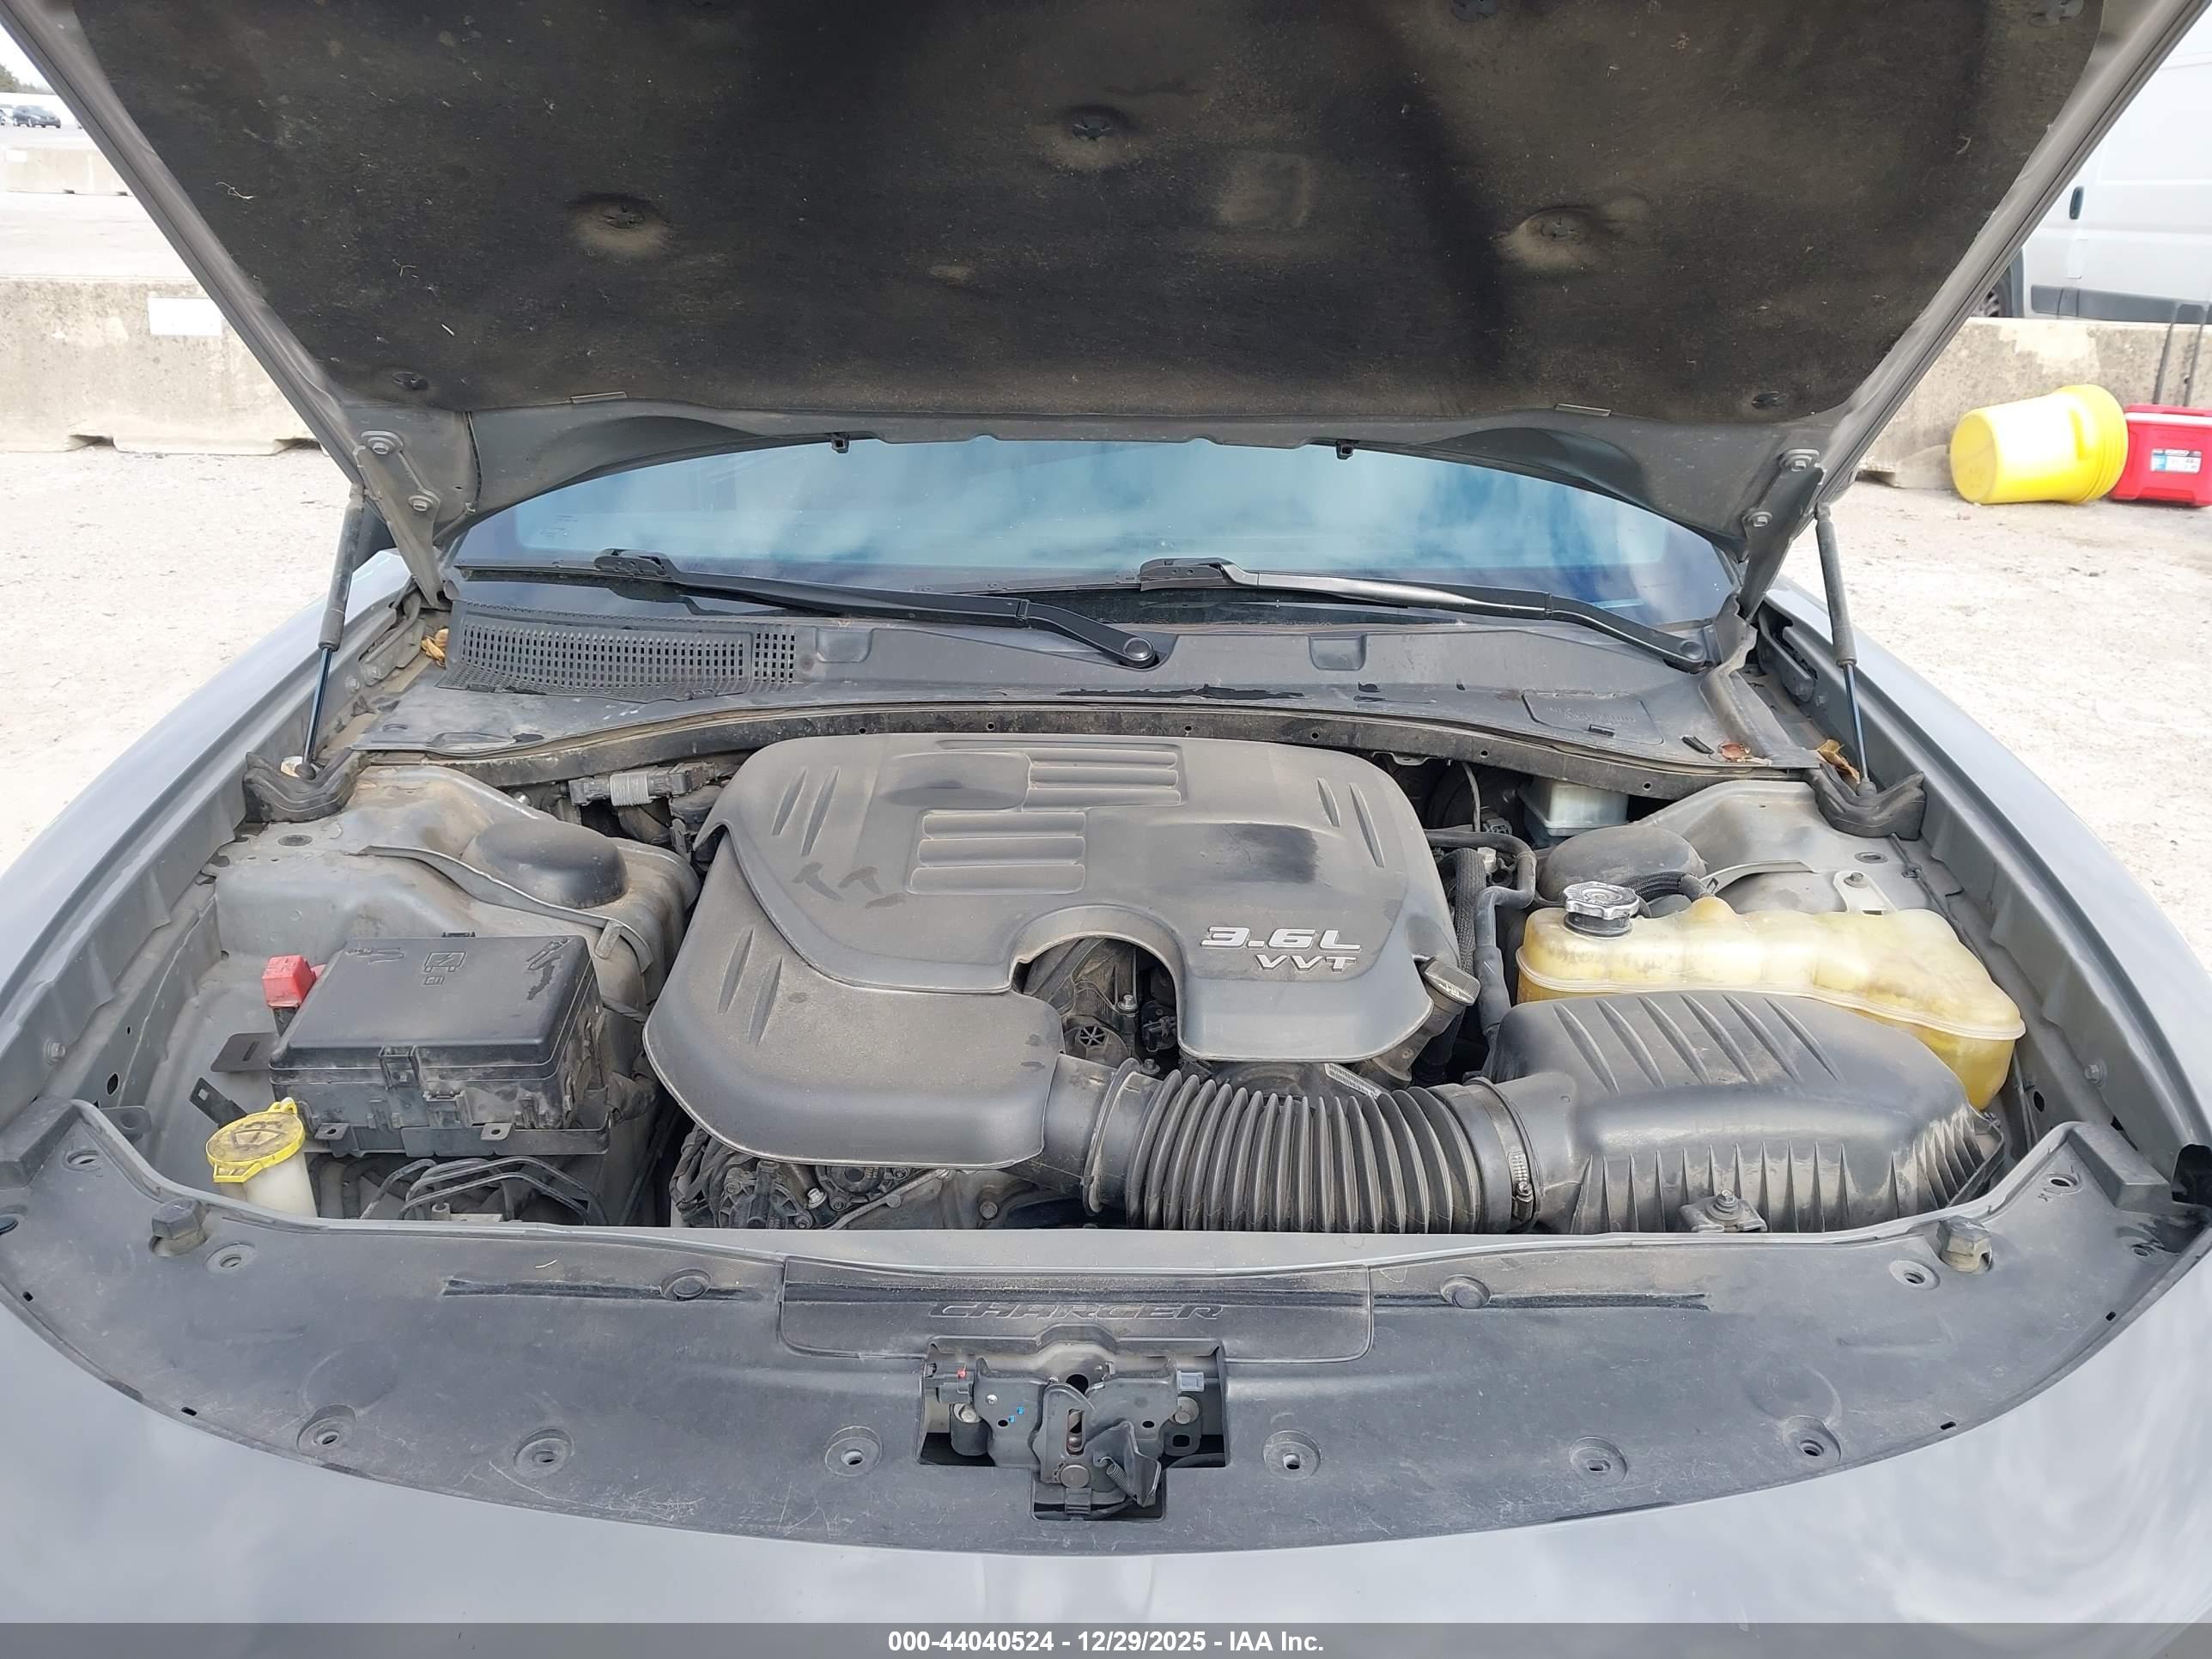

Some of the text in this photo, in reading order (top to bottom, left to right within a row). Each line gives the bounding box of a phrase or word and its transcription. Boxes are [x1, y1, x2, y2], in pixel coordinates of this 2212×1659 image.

[1200, 926, 1362, 951] 3.6L
[1254, 954, 1358, 972] VVT
[928, 1303, 1224, 1320] CHARGER
